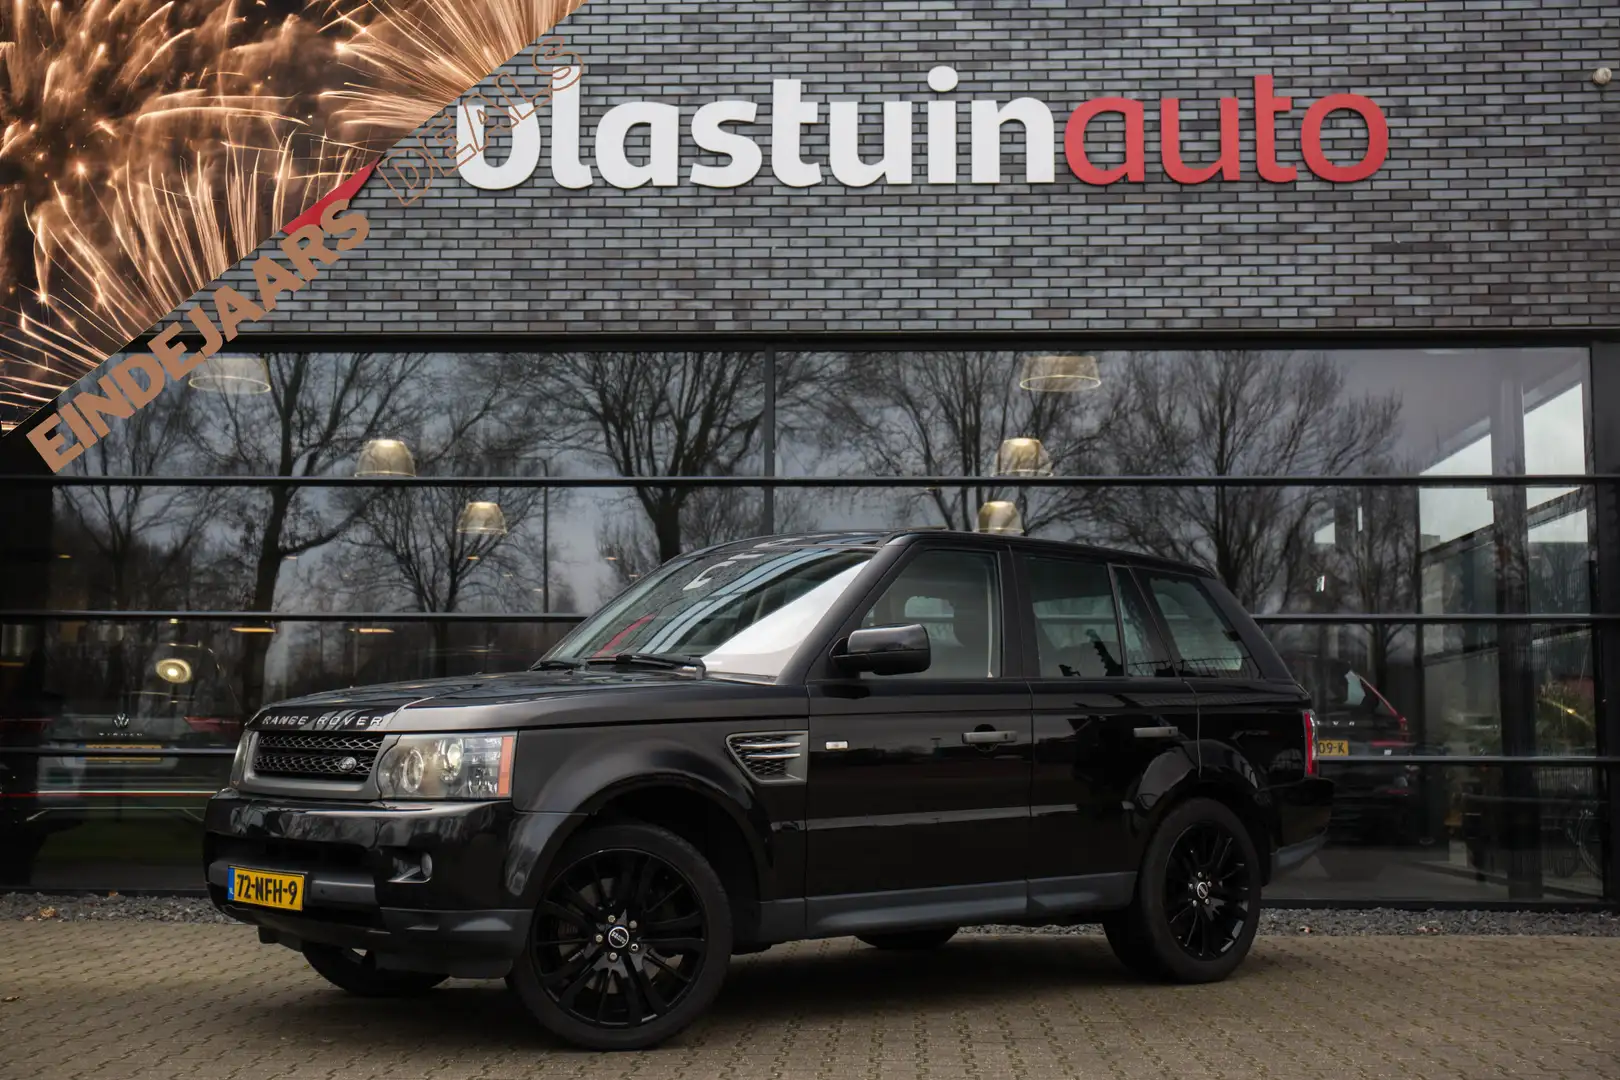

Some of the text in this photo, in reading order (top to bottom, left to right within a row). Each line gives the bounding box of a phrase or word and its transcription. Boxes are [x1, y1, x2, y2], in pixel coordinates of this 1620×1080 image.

[261, 715, 384, 727] RANGE ROVER
[236, 873, 298, 906] 72-NFH-9
